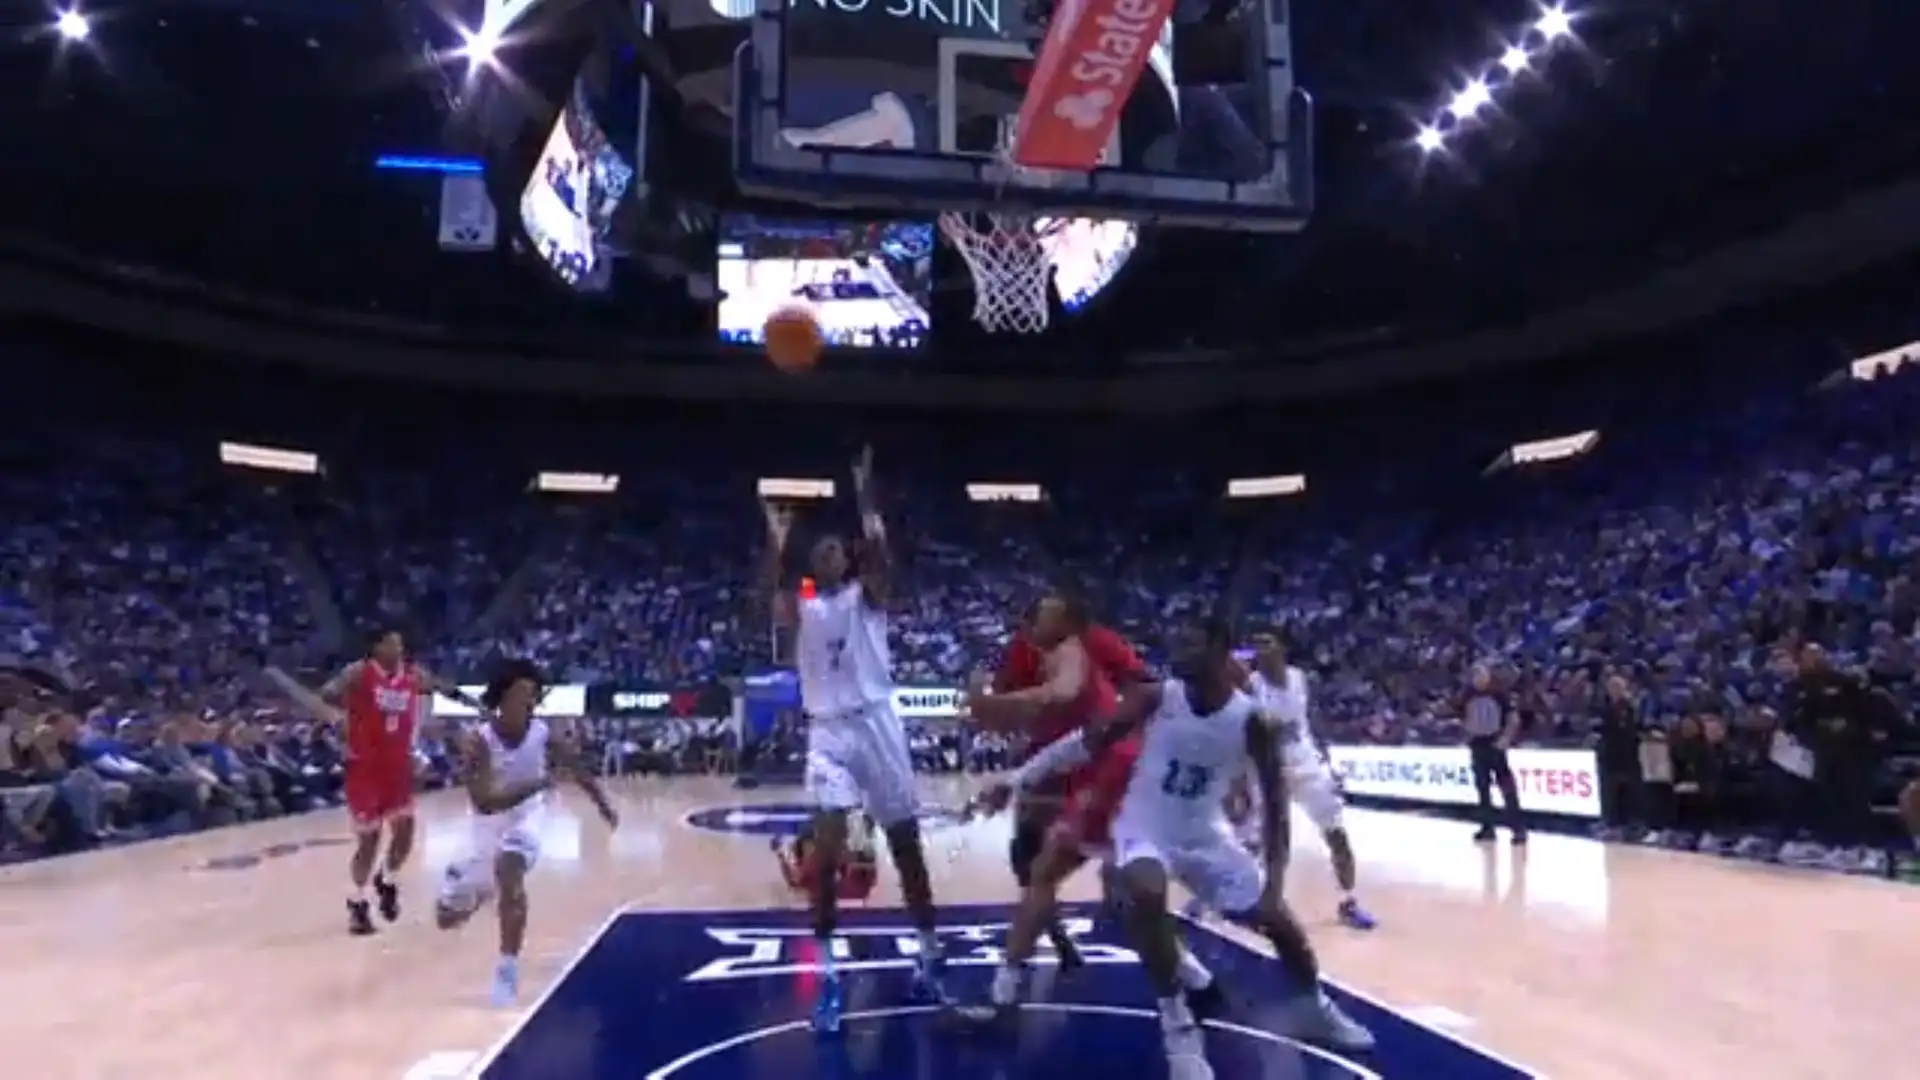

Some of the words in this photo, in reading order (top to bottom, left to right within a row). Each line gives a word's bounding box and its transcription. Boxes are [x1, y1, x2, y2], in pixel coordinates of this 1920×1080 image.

[1071, 0, 1158, 86] State
[1427, 762, 1473, 787] WHA
[1517, 766, 1593, 799] TTERS
